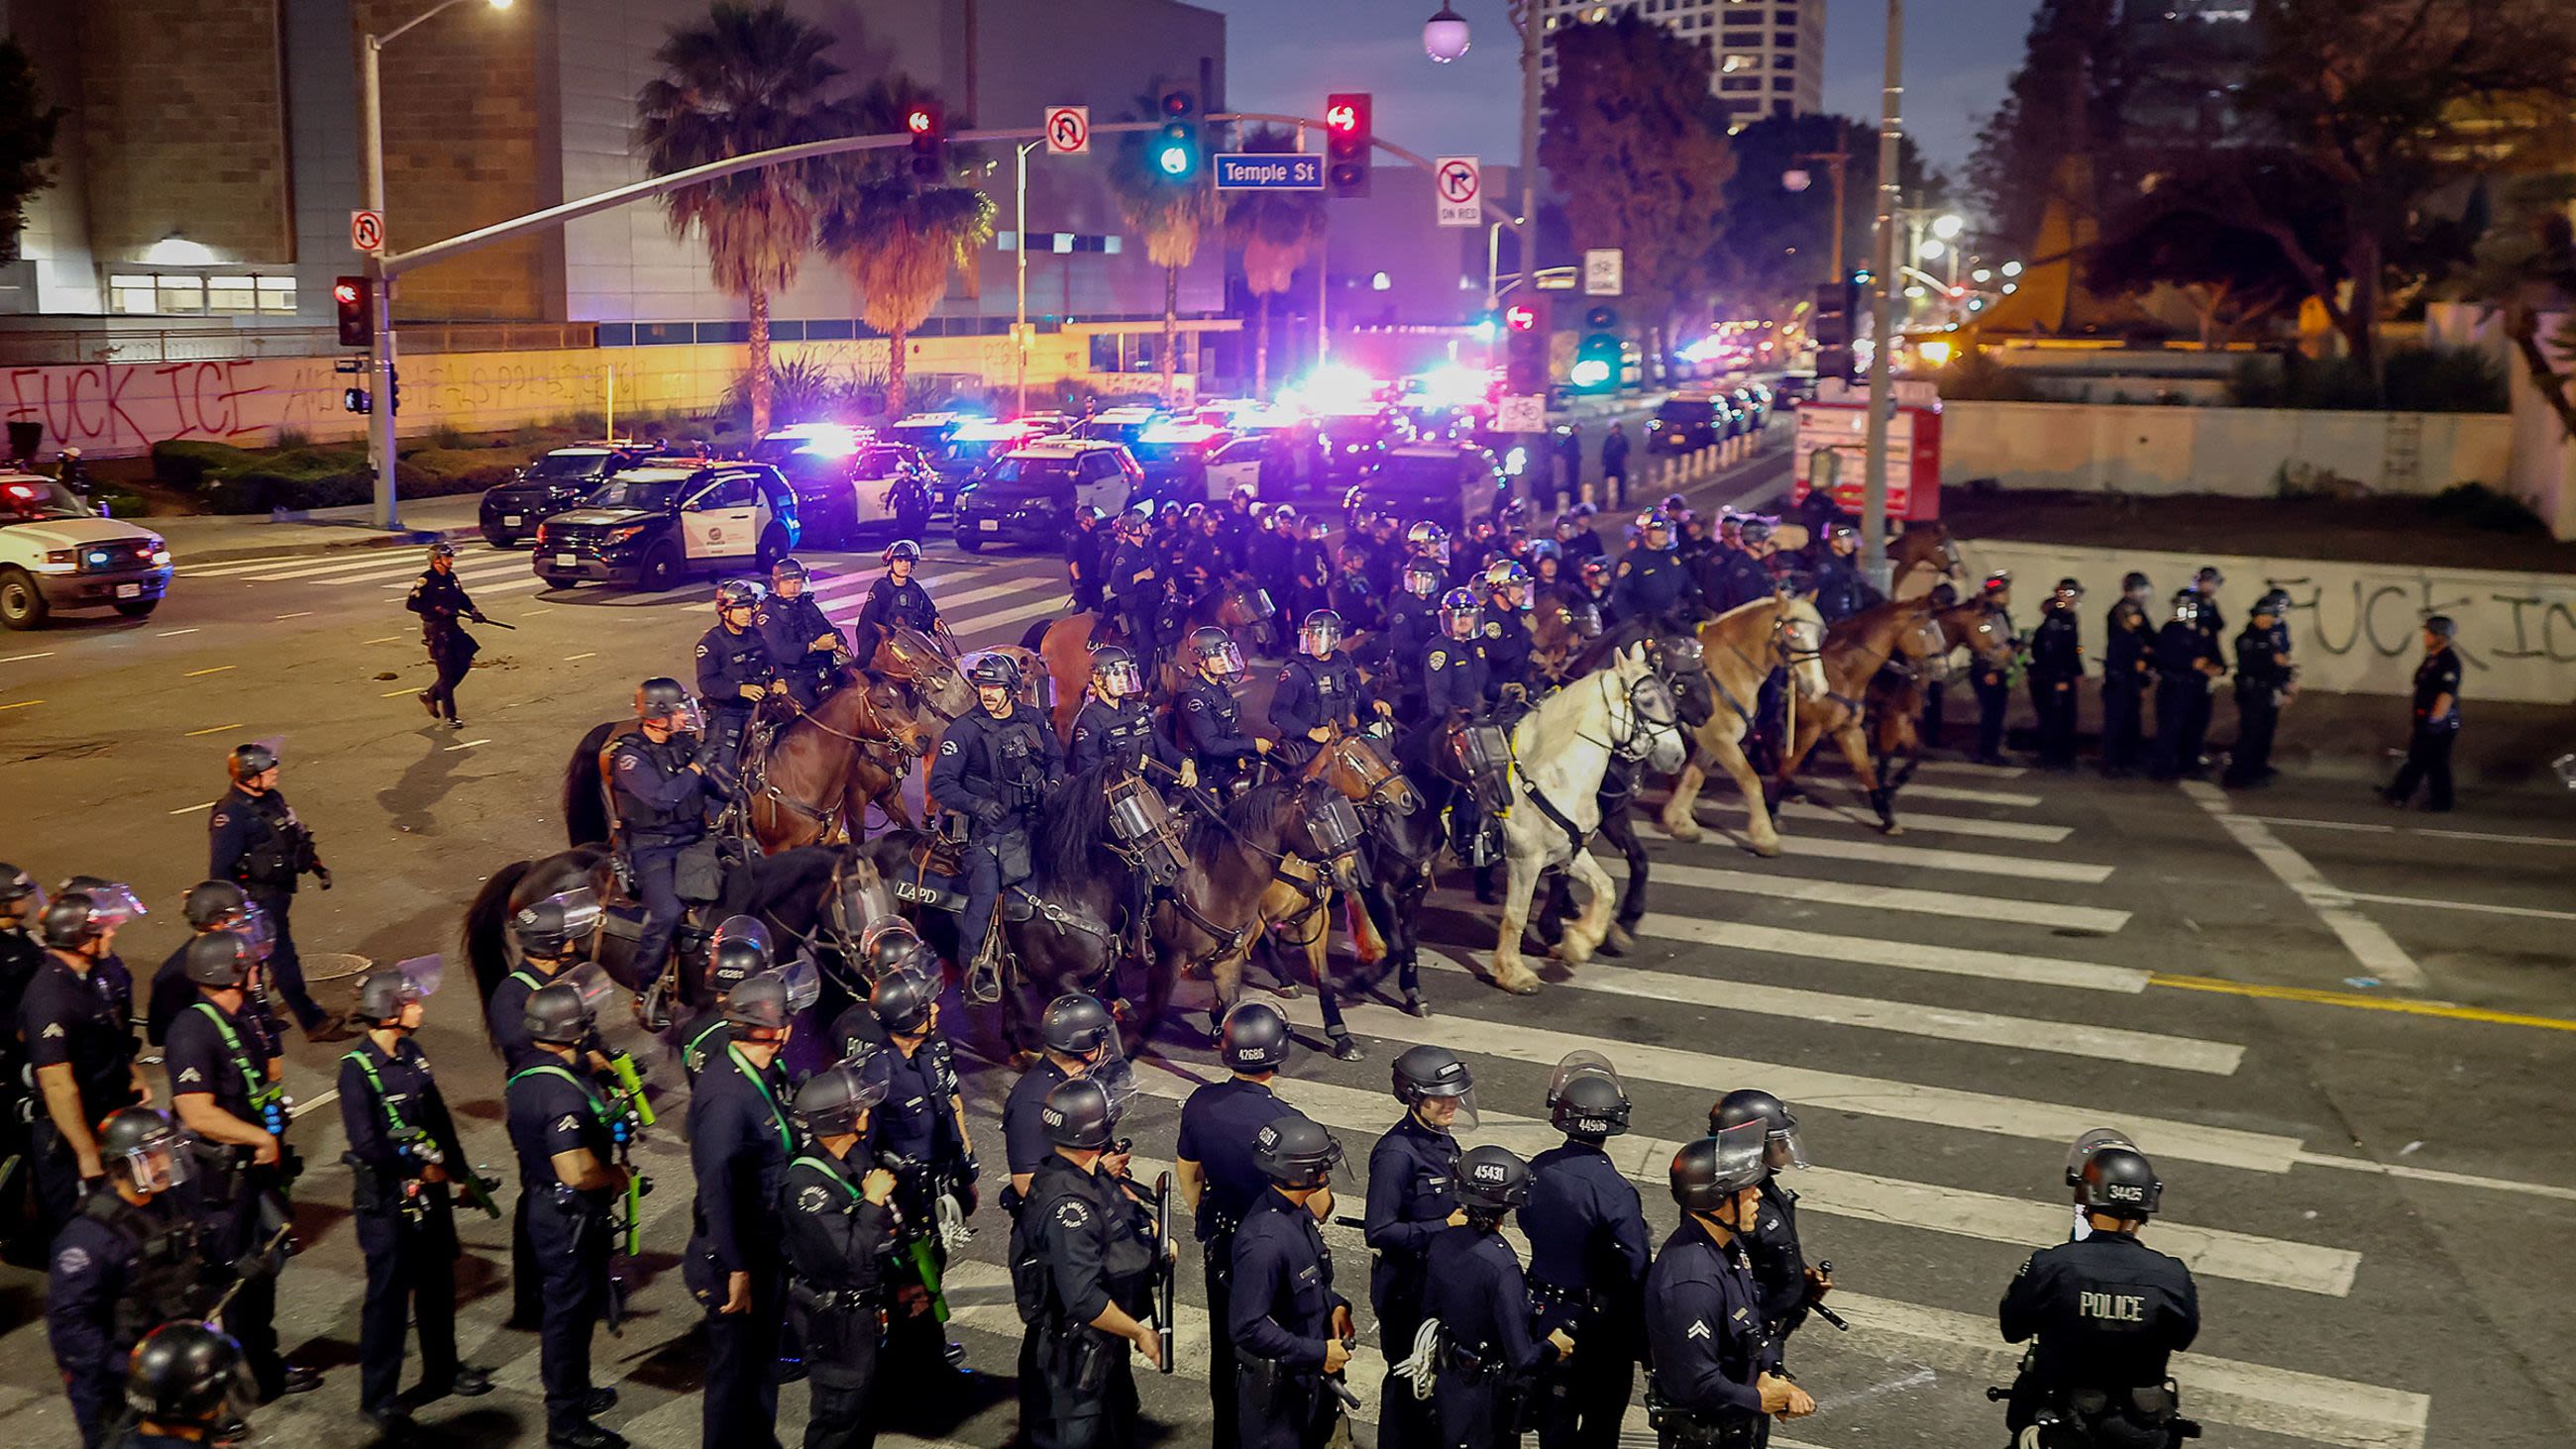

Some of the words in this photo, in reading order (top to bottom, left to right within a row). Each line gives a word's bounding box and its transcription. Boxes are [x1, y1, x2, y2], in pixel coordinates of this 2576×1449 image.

[1225, 161, 1287, 184] Temple
[1294, 162, 1316, 181] St
[1442, 208, 1455, 219] ON
[1458, 208, 1476, 219] RED
[8, 362, 151, 445] FUCK
[156, 360, 275, 441] ICE
[896, 881, 937, 904] LAPD
[1474, 1164, 1504, 1182] 45431
[2080, 1291, 2146, 1322] POLICE
